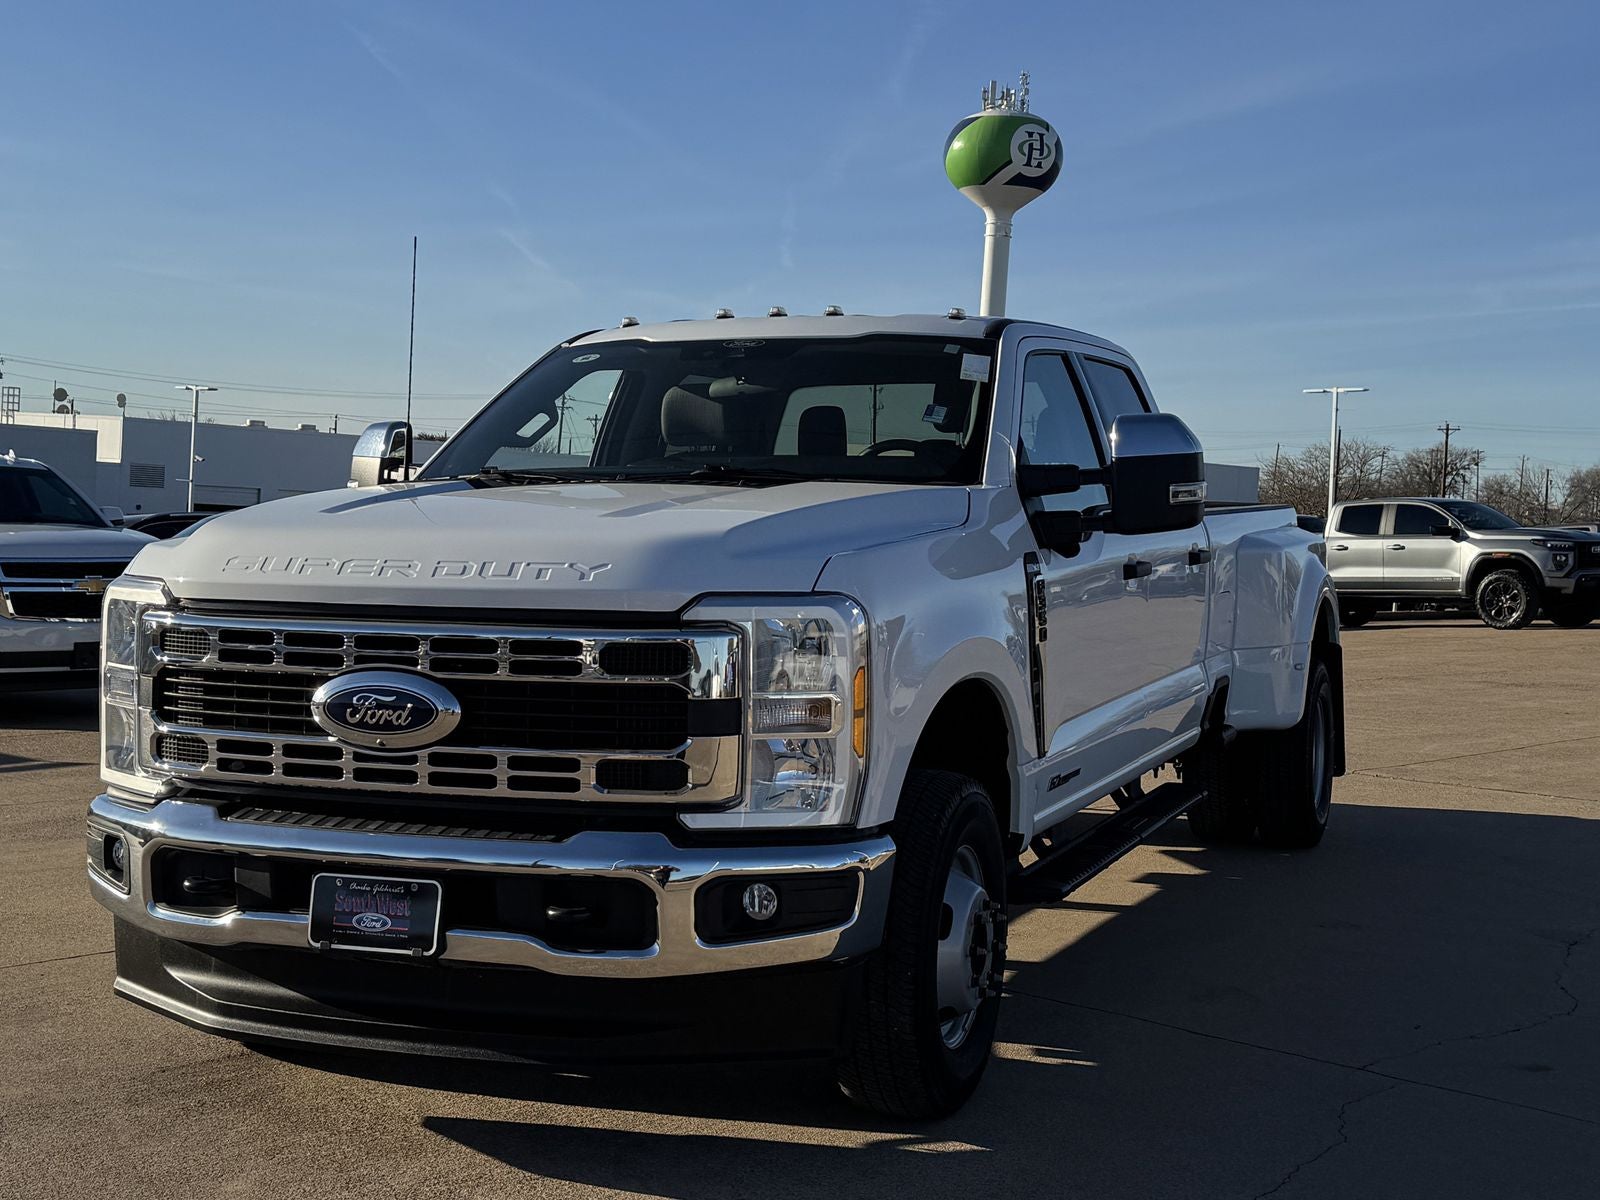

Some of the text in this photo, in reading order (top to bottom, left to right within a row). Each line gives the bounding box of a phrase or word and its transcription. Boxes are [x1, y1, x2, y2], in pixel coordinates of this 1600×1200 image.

[222, 555, 613, 582] SUPER DUTY
[346, 693, 413, 725] Ford
[360, 915, 384, 928] Ford
